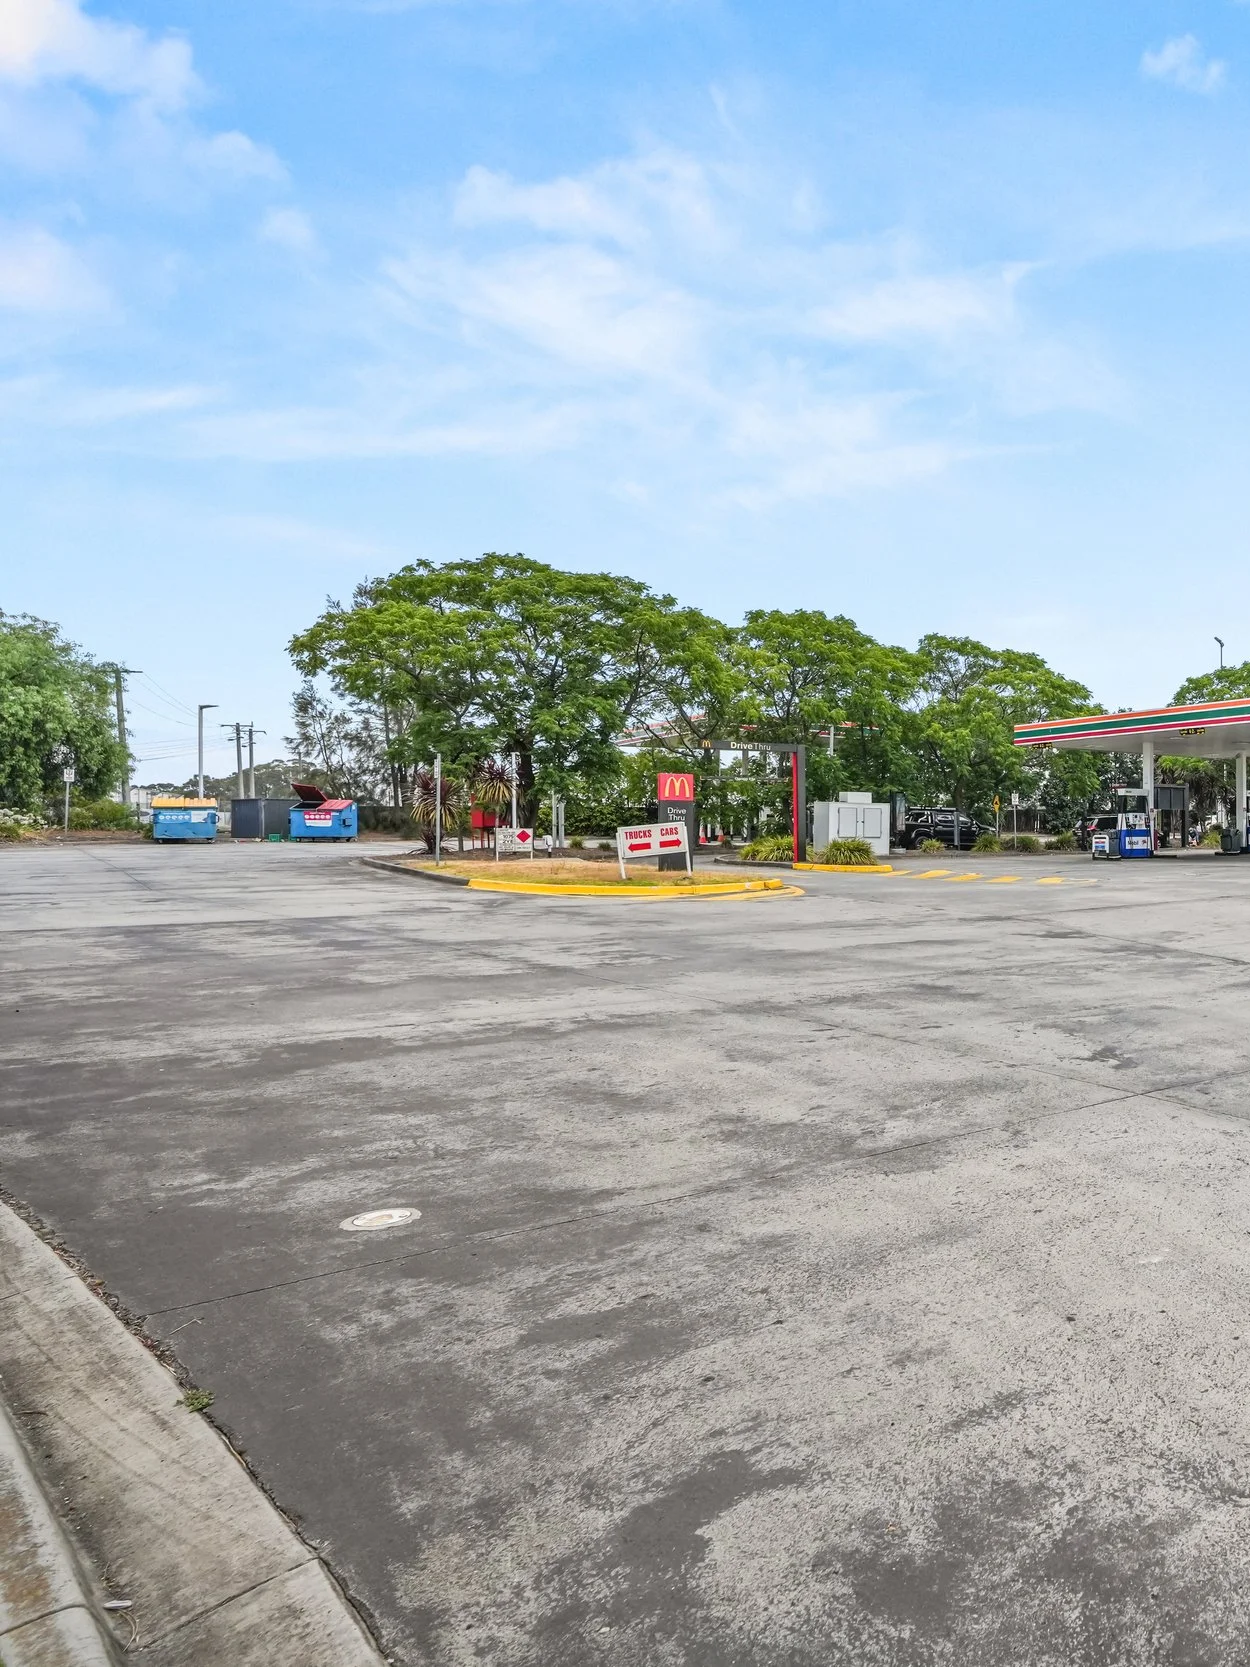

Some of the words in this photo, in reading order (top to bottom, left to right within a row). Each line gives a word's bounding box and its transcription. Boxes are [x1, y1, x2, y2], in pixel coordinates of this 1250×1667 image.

[730, 742, 753, 750] Drive
[754, 743, 771, 751] Thru
[667, 807, 687, 815] Drive
[668, 813, 686, 821] Thru
[624, 830, 652, 841] TRUCKS
[660, 827, 679, 837] CARS
